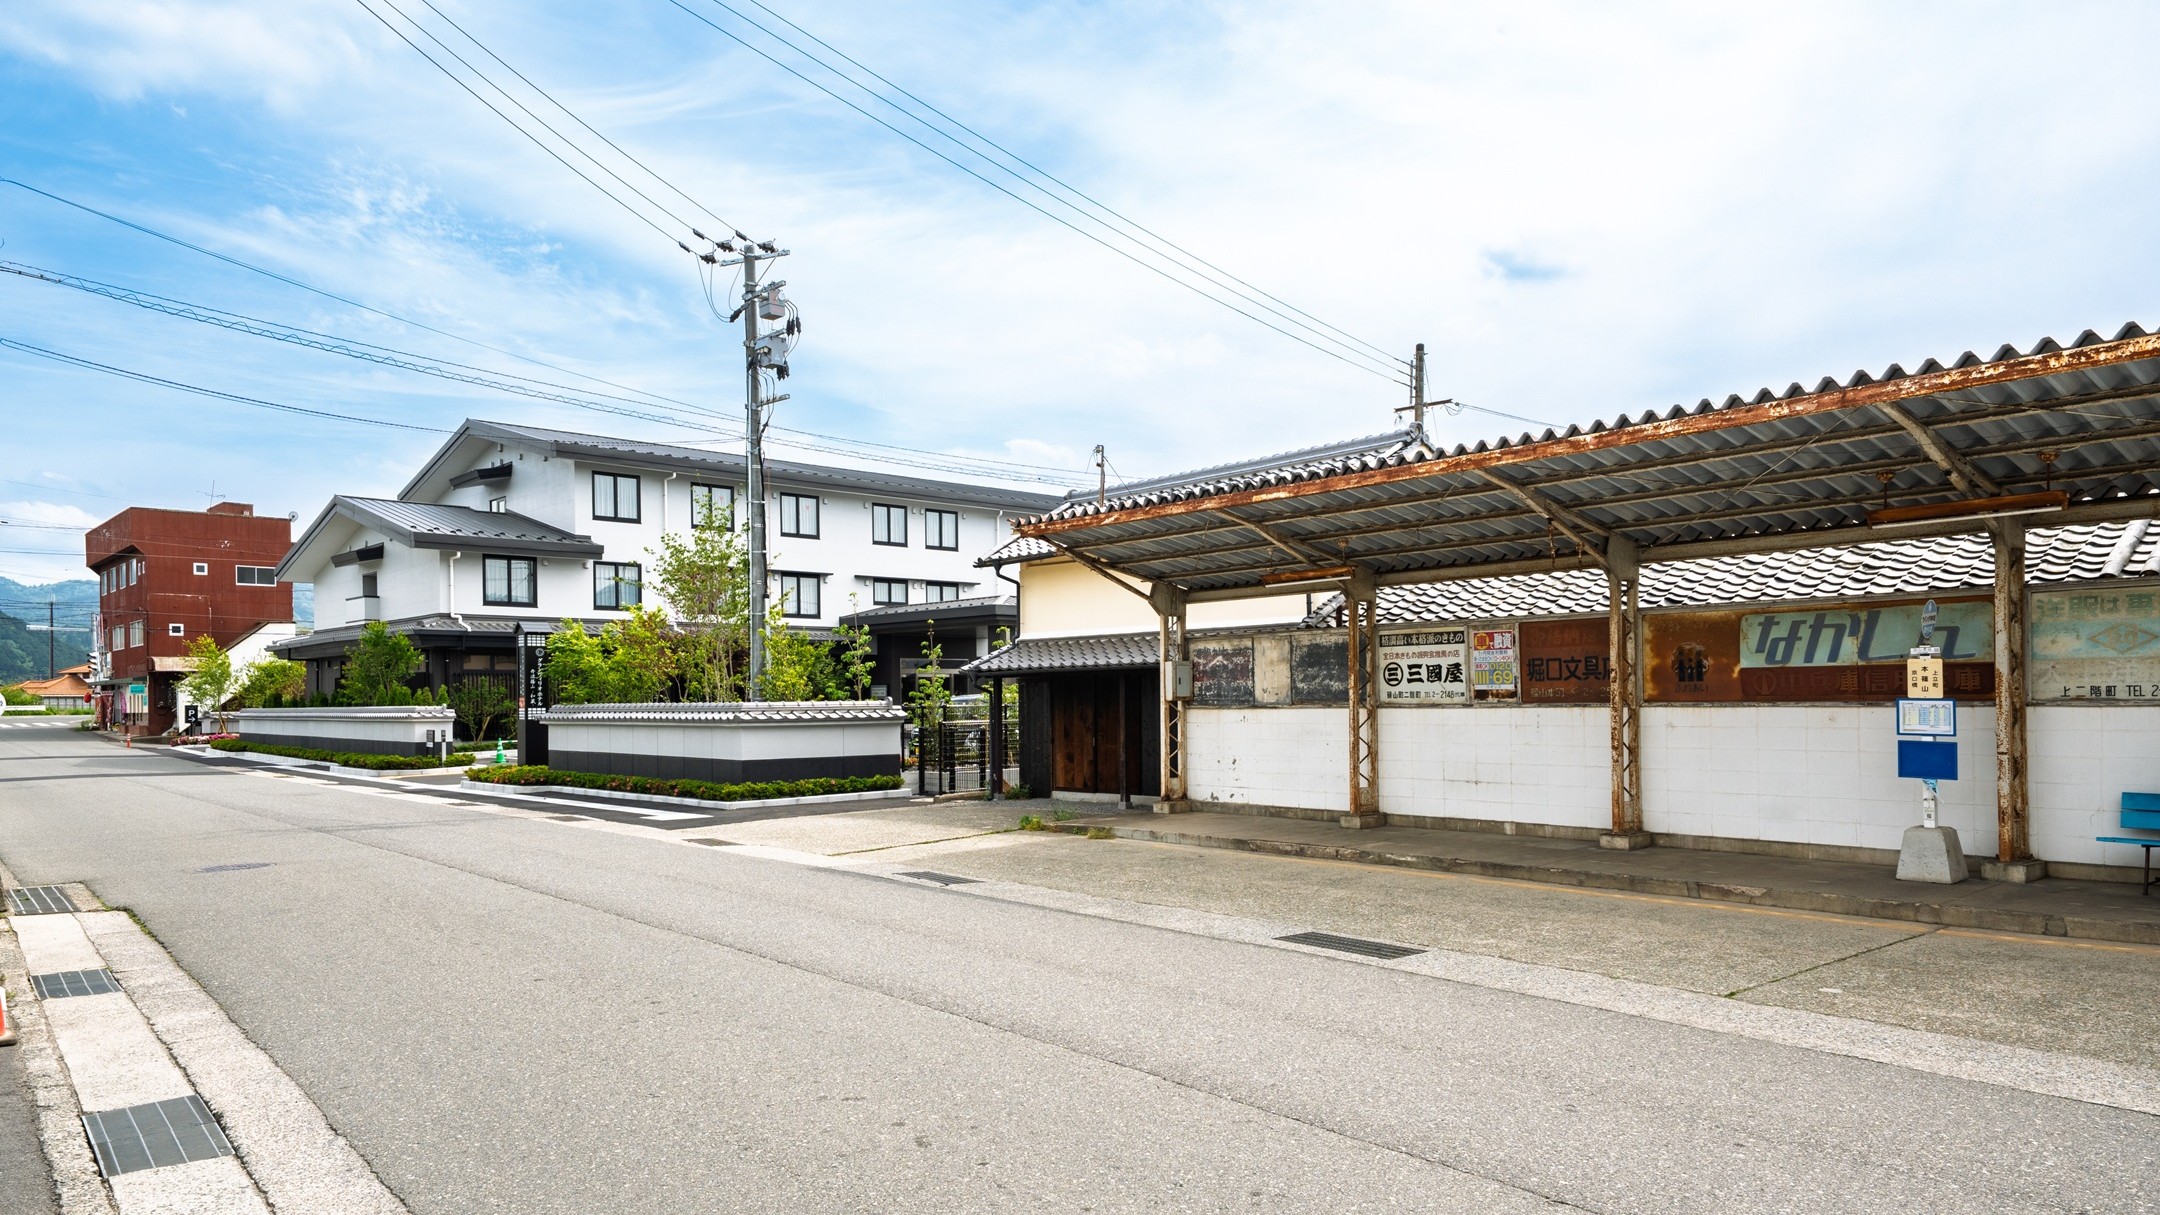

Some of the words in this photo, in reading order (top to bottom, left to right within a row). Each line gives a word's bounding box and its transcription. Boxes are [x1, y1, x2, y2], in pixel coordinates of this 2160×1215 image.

[1754, 607, 1976, 665] なかしん
[1406, 662, 1464, 684] 三國屋
[1490, 662, 1512, 670] 0120
[1921, 666, 1929, 692] 本篠山
[2060, 685, 2118, 697] 上二階町
[2125, 685, 2146, 697] TEL
[188, 709, 195, 717] P
